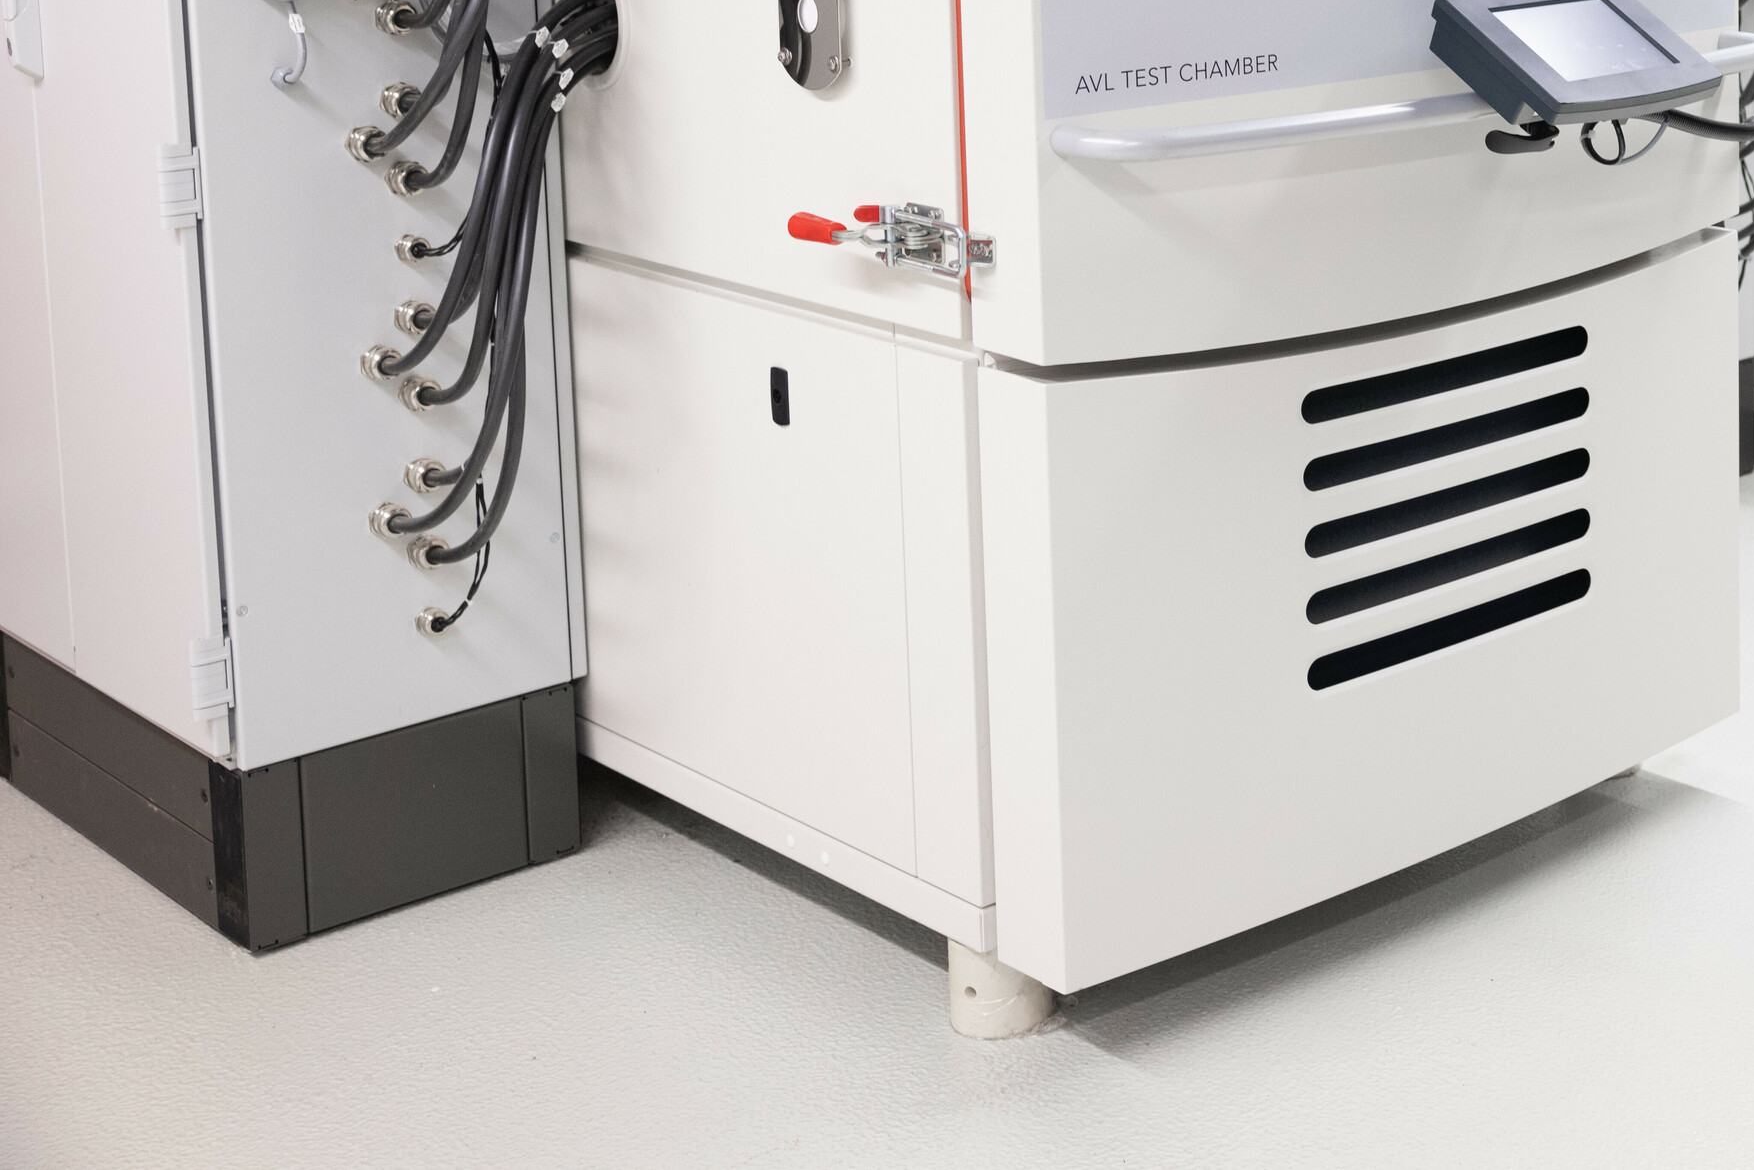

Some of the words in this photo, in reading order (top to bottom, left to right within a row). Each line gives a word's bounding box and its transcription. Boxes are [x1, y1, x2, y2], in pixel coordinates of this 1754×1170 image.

[1075, 72, 1115, 95] AVL
[1121, 65, 1172, 89] TEST
[1179, 53, 1279, 82] CHAMBER
